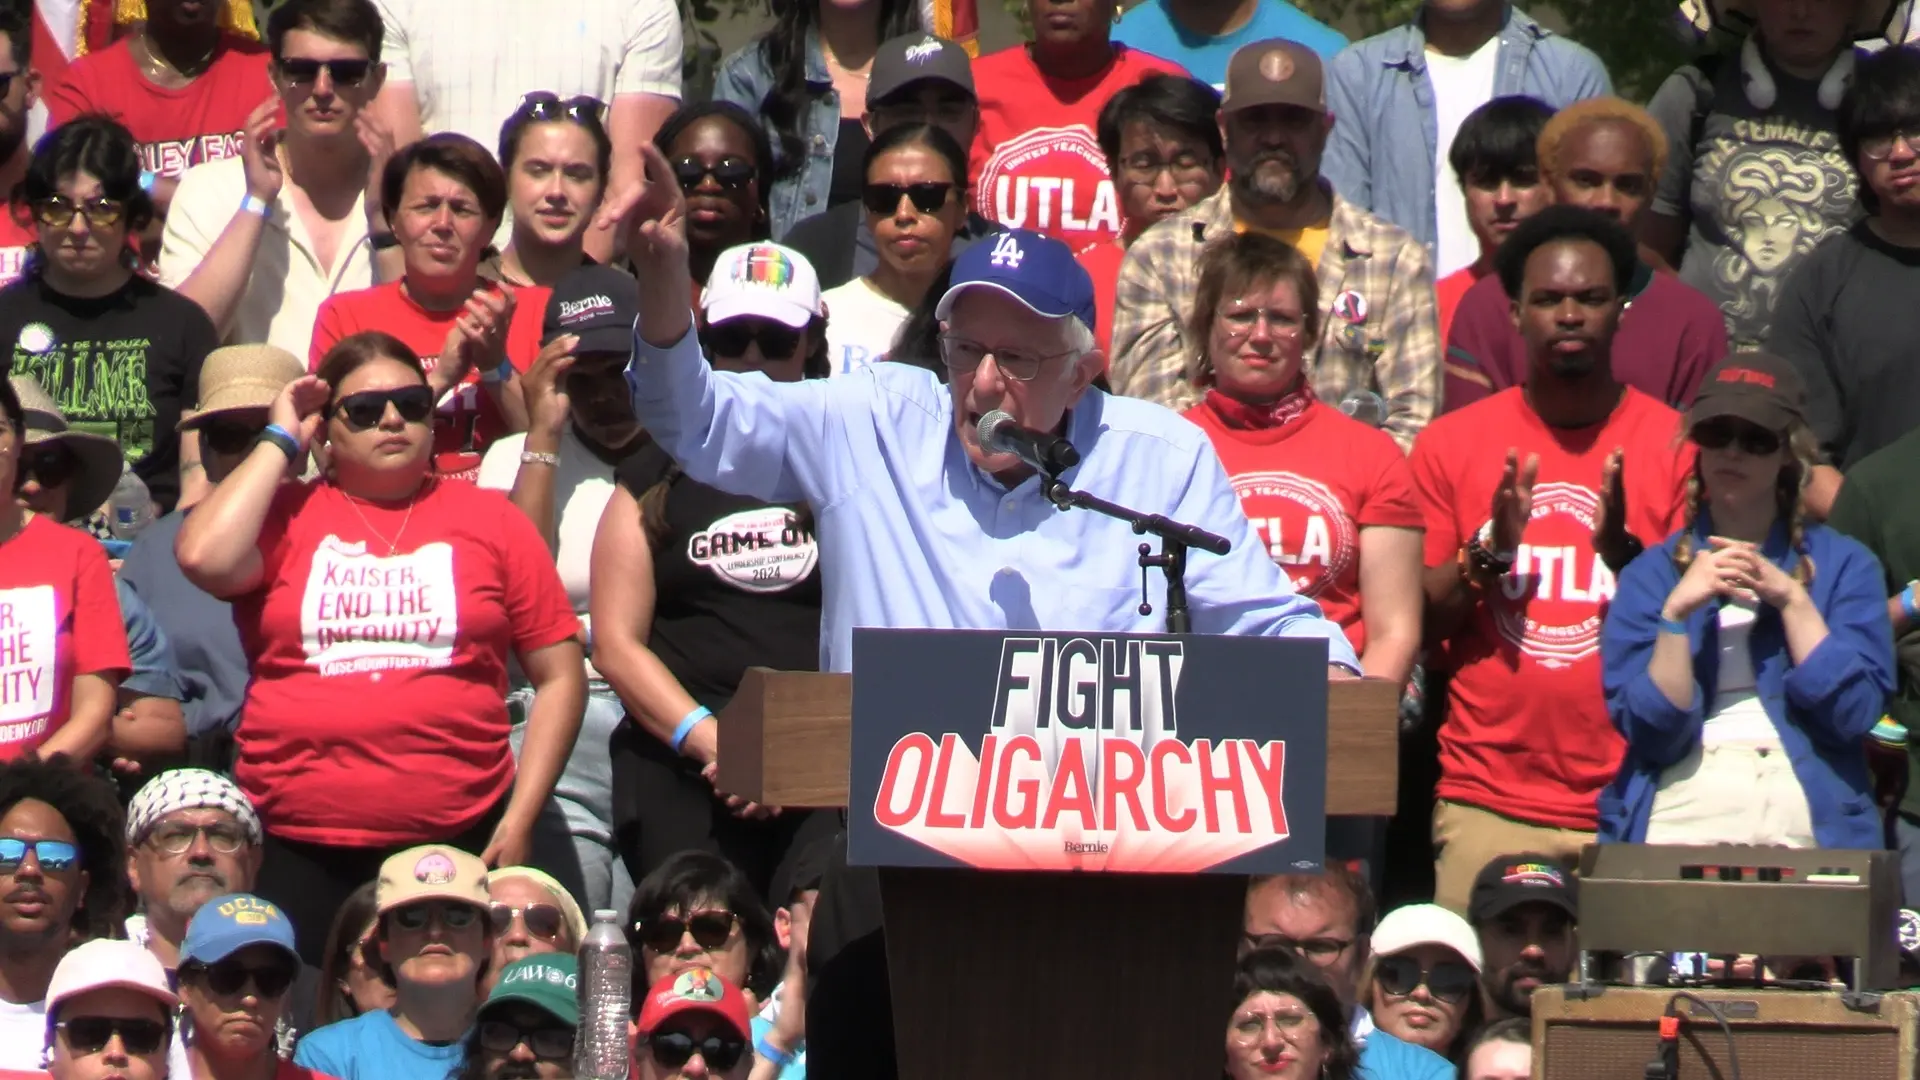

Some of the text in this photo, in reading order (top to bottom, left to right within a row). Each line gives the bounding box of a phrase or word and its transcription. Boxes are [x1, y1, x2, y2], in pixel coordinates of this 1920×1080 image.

[1004, 146, 1050, 170] UNITED
[996, 174, 1120, 232] UTLA
[990, 232, 1024, 268] LA
[559, 293, 613, 317] Bernie
[106, 338, 150, 349] SOUZA
[690, 530, 774, 559] GAME
[753, 566, 781, 581] 2024
[318, 584, 432, 621] END THE
[318, 617, 442, 650] INEQUITY
[1538, 615, 1601, 636] ANGELES
[990, 637, 1185, 732] FIGHT
[873, 732, 1290, 837] OLIGARCHY
[1064, 841, 1109, 855] Bernie
[217, 897, 280, 920] UCLA
[504, 965, 543, 984] UAW
